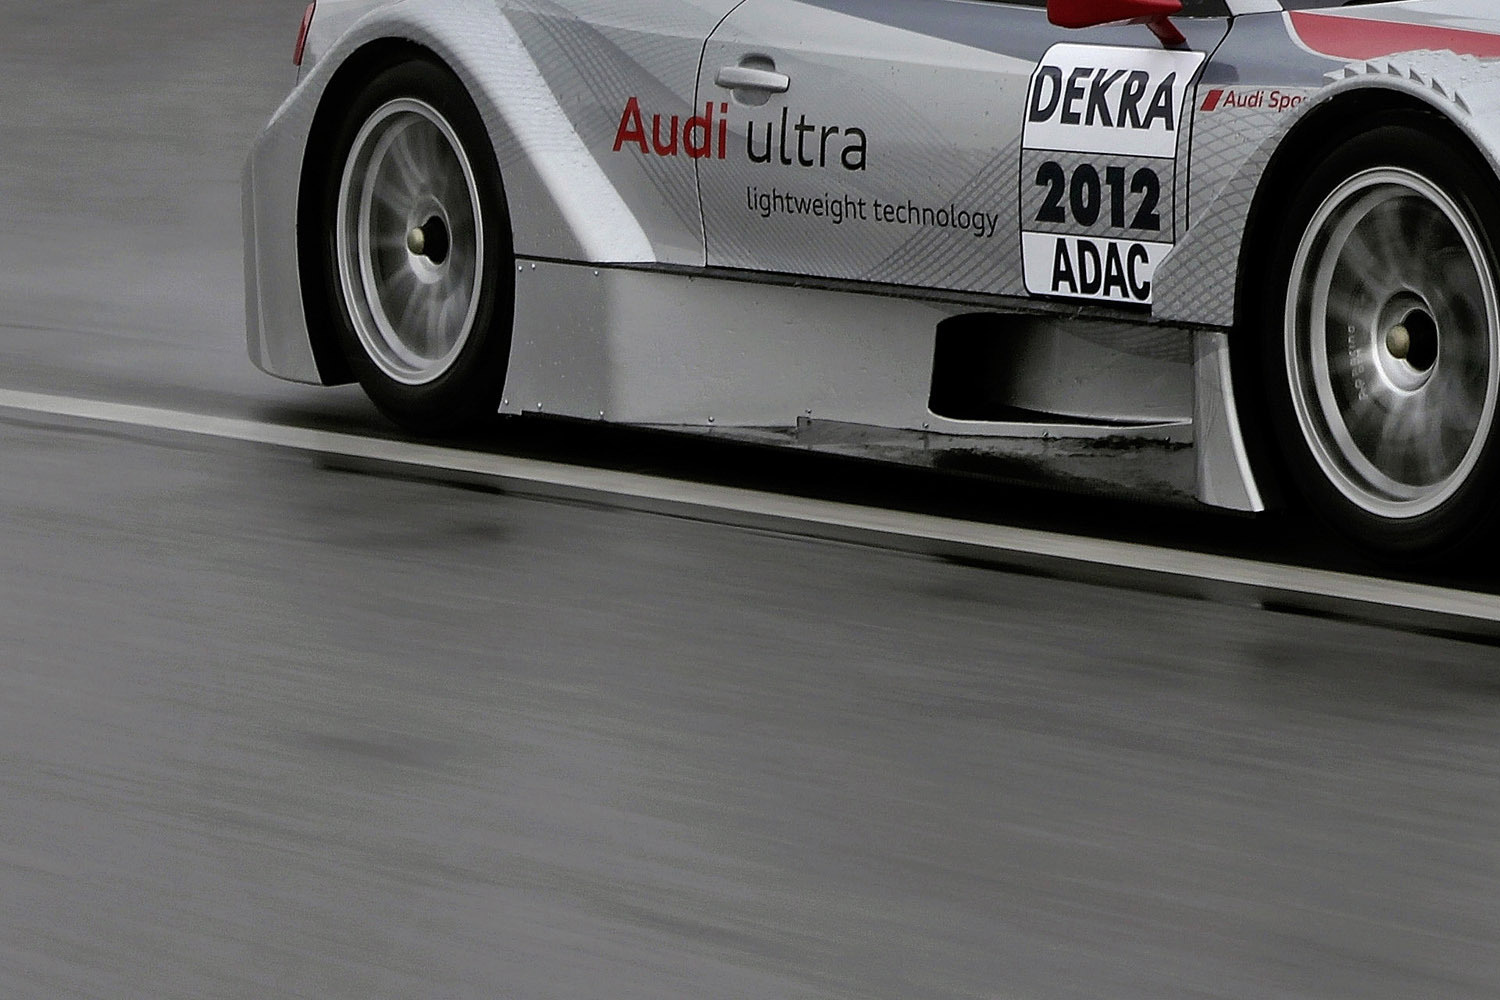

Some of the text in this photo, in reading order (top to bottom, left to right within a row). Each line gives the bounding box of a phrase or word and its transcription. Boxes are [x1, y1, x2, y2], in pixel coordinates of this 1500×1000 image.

[1028, 65, 1176, 131] DEKRA
[1223, 90, 1264, 108] Audi
[612, 96, 868, 171] Audi ultra
[746, 187, 999, 238] lightweight technology
[1035, 161, 1161, 231] 2012
[1051, 238, 1150, 301] ADAC
